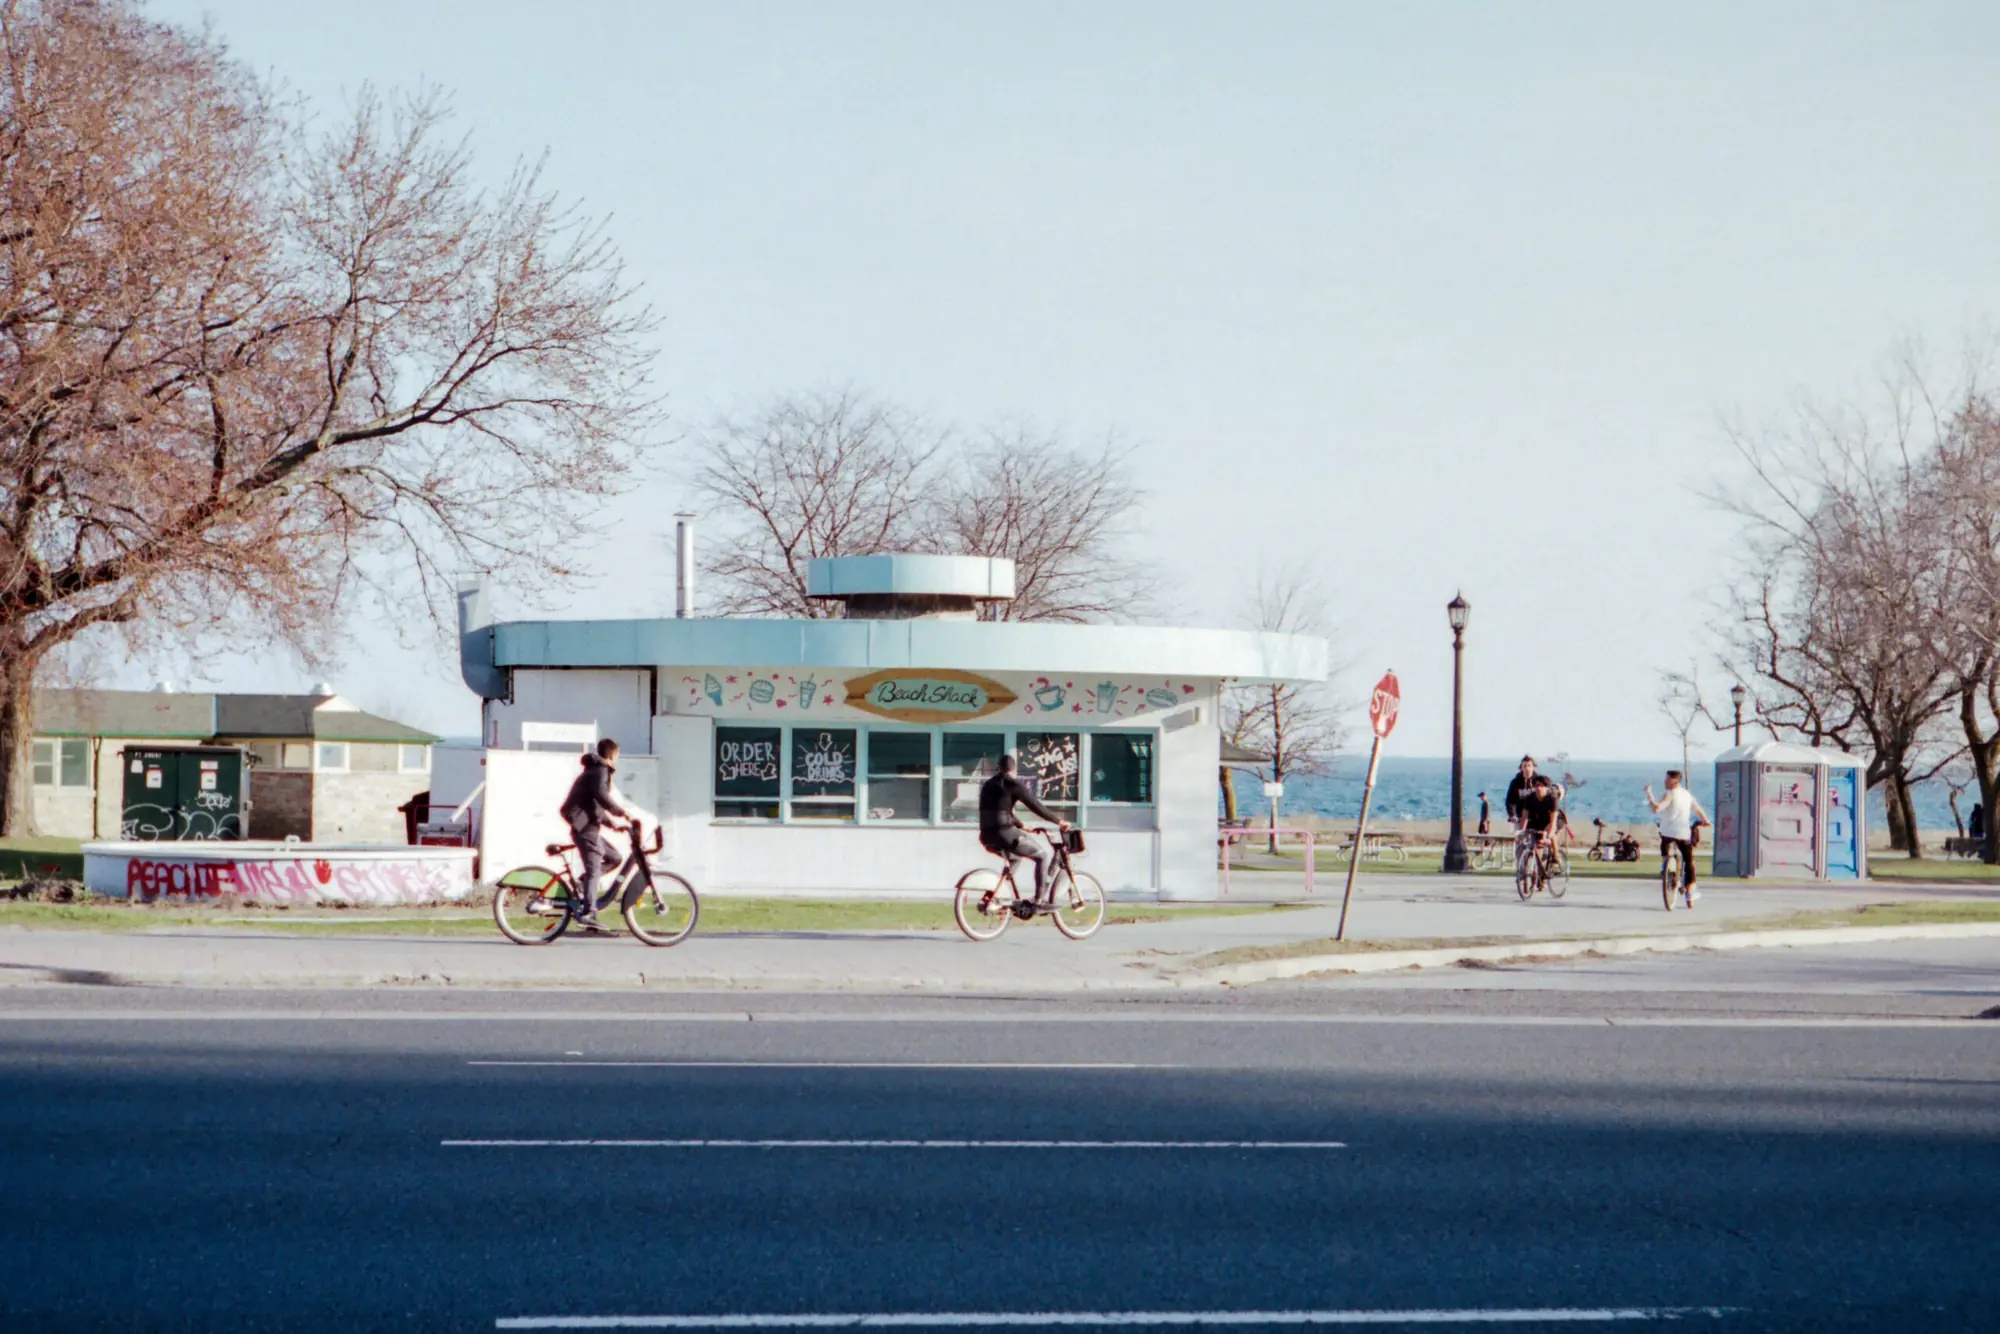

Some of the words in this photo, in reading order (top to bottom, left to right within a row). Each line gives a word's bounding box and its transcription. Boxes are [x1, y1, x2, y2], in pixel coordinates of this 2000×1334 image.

[877, 680, 929, 703] Beach
[929, 685, 980, 708] Shack
[1371, 688, 1400, 721] STOP
[720, 741, 775, 763] ORDER
[805, 751, 844, 767] COLD
[1034, 747, 1064, 767] TAG
[735, 762, 761, 777] HERE
